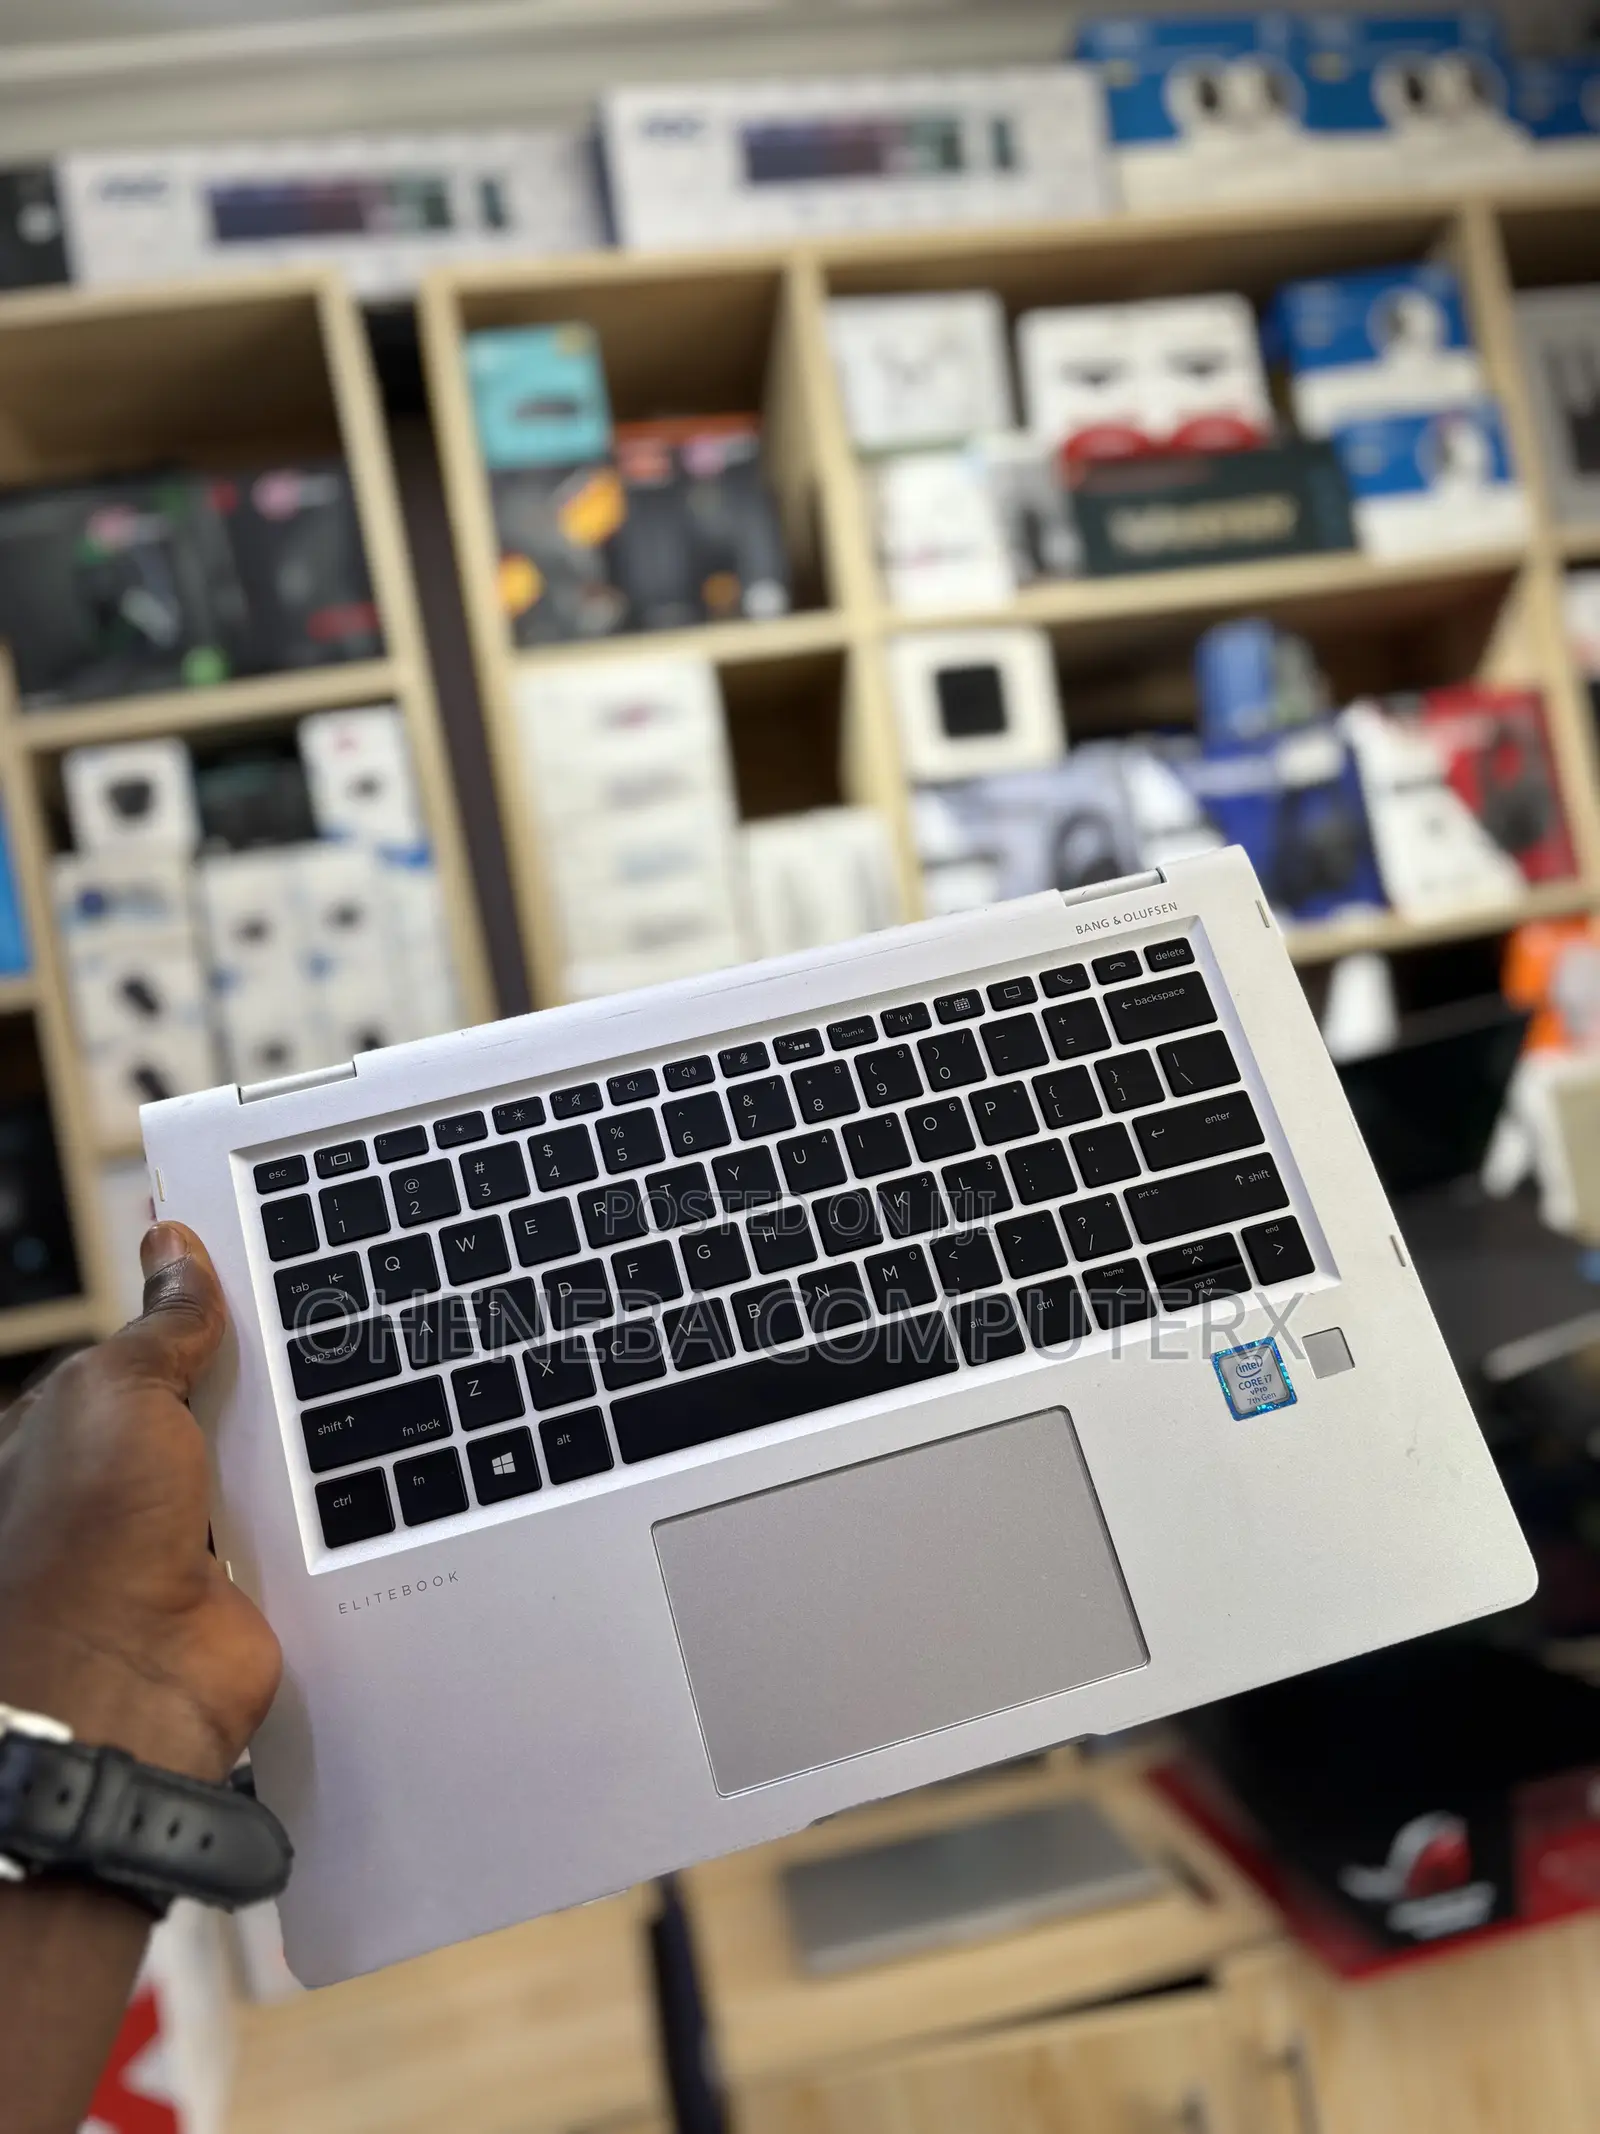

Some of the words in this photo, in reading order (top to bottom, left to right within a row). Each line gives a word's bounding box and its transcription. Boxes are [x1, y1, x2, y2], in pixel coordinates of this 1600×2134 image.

[1075, 919, 1110, 935] BANG
[1113, 916, 1121, 925] &
[1123, 902, 1178, 923] OLUFSEN
[1155, 947, 1185, 961] delete
[1134, 986, 1185, 1007] backspace
[897, 1050, 905, 1059] 9
[834, 1065, 842, 1074] 8
[769, 1081, 776, 1091] 7
[876, 1082, 888, 1096] 9
[743, 1094, 754, 1107] &
[813, 1098, 824, 1111] 8
[948, 1102, 956, 1111] 6
[984, 1101, 997, 1116] P
[747, 1114, 757, 1128] 7
[885, 1119, 893, 1128] 5
[923, 1116, 938, 1131] O
[1204, 1111, 1230, 1124] enter
[610, 1126, 625, 1140] %
[682, 1131, 694, 1144] 6
[821, 1135, 828, 1144] 4
[542, 1144, 554, 1158] $
[617, 1147, 628, 1162] 5
[792, 1149, 807, 1164] U
[474, 1161, 485, 1175] #
[549, 1165, 561, 1178] 4
[985, 1161, 993, 1170] 3
[268, 1168, 287, 1180] esc
[727, 1166, 740, 1181] Y
[1248, 1169, 1270, 1183] shift
[404, 1178, 420, 1193] @
[480, 1182, 491, 1197] 3
[921, 1178, 928, 1187] 2
[958, 1176, 972, 1191] L
[660, 1183, 671, 1198] T
[1138, 1190, 1149, 1200] prt
[1150, 1189, 1159, 1197] sc
[893, 1191, 908, 1208] K
[409, 1201, 421, 1215] 2
[593, 1201, 608, 1217] R
[830, 1209, 839, 1225] J
[1077, 1217, 1086, 1230] ?
[338, 1220, 346, 1233] 1
[524, 1219, 538, 1235] E
[1265, 1225, 1279, 1234] end
[762, 1226, 777, 1243] H
[455, 1235, 476, 1252] W
[1182, 1247, 1193, 1256] pg
[1194, 1244, 1204, 1253] up
[697, 1245, 711, 1259] G
[385, 1256, 401, 1271] Q
[627, 1263, 639, 1279] F
[881, 1265, 899, 1282] M
[1103, 1267, 1125, 1278] home
[291, 1282, 310, 1294] tab
[558, 1282, 572, 1298] D
[1194, 1281, 1205, 1290] pg
[1205, 1277, 1216, 1286] dn
[815, 1284, 831, 1300] N
[488, 1301, 501, 1317] S
[747, 1303, 761, 1319] B
[1036, 1298, 1054, 1311] ctrl
[419, 1321, 434, 1336] A
[679, 1321, 692, 1337] V
[970, 1317, 984, 1329] alt
[304, 1351, 331, 1365] caps
[333, 1343, 357, 1357] lock
[610, 1340, 625, 1356] C
[539, 1360, 554, 1378] X
[1238, 1357, 1261, 1373] intel
[467, 1380, 481, 1397] Z
[1239, 1378, 1263, 1391] CORE
[1264, 1374, 1273, 1384] i7
[1250, 1386, 1268, 1395] vPro
[1247, 1396, 1260, 1405] 7th
[1261, 1392, 1276, 1402] Gen
[317, 1422, 343, 1436] shift
[402, 1426, 414, 1437] fn
[416, 1418, 441, 1433] lock
[556, 1433, 572, 1446] alt
[412, 1475, 425, 1486] fn
[333, 1494, 352, 1508] ctrl
[338, 1571, 459, 1615] ELITEBOOK
